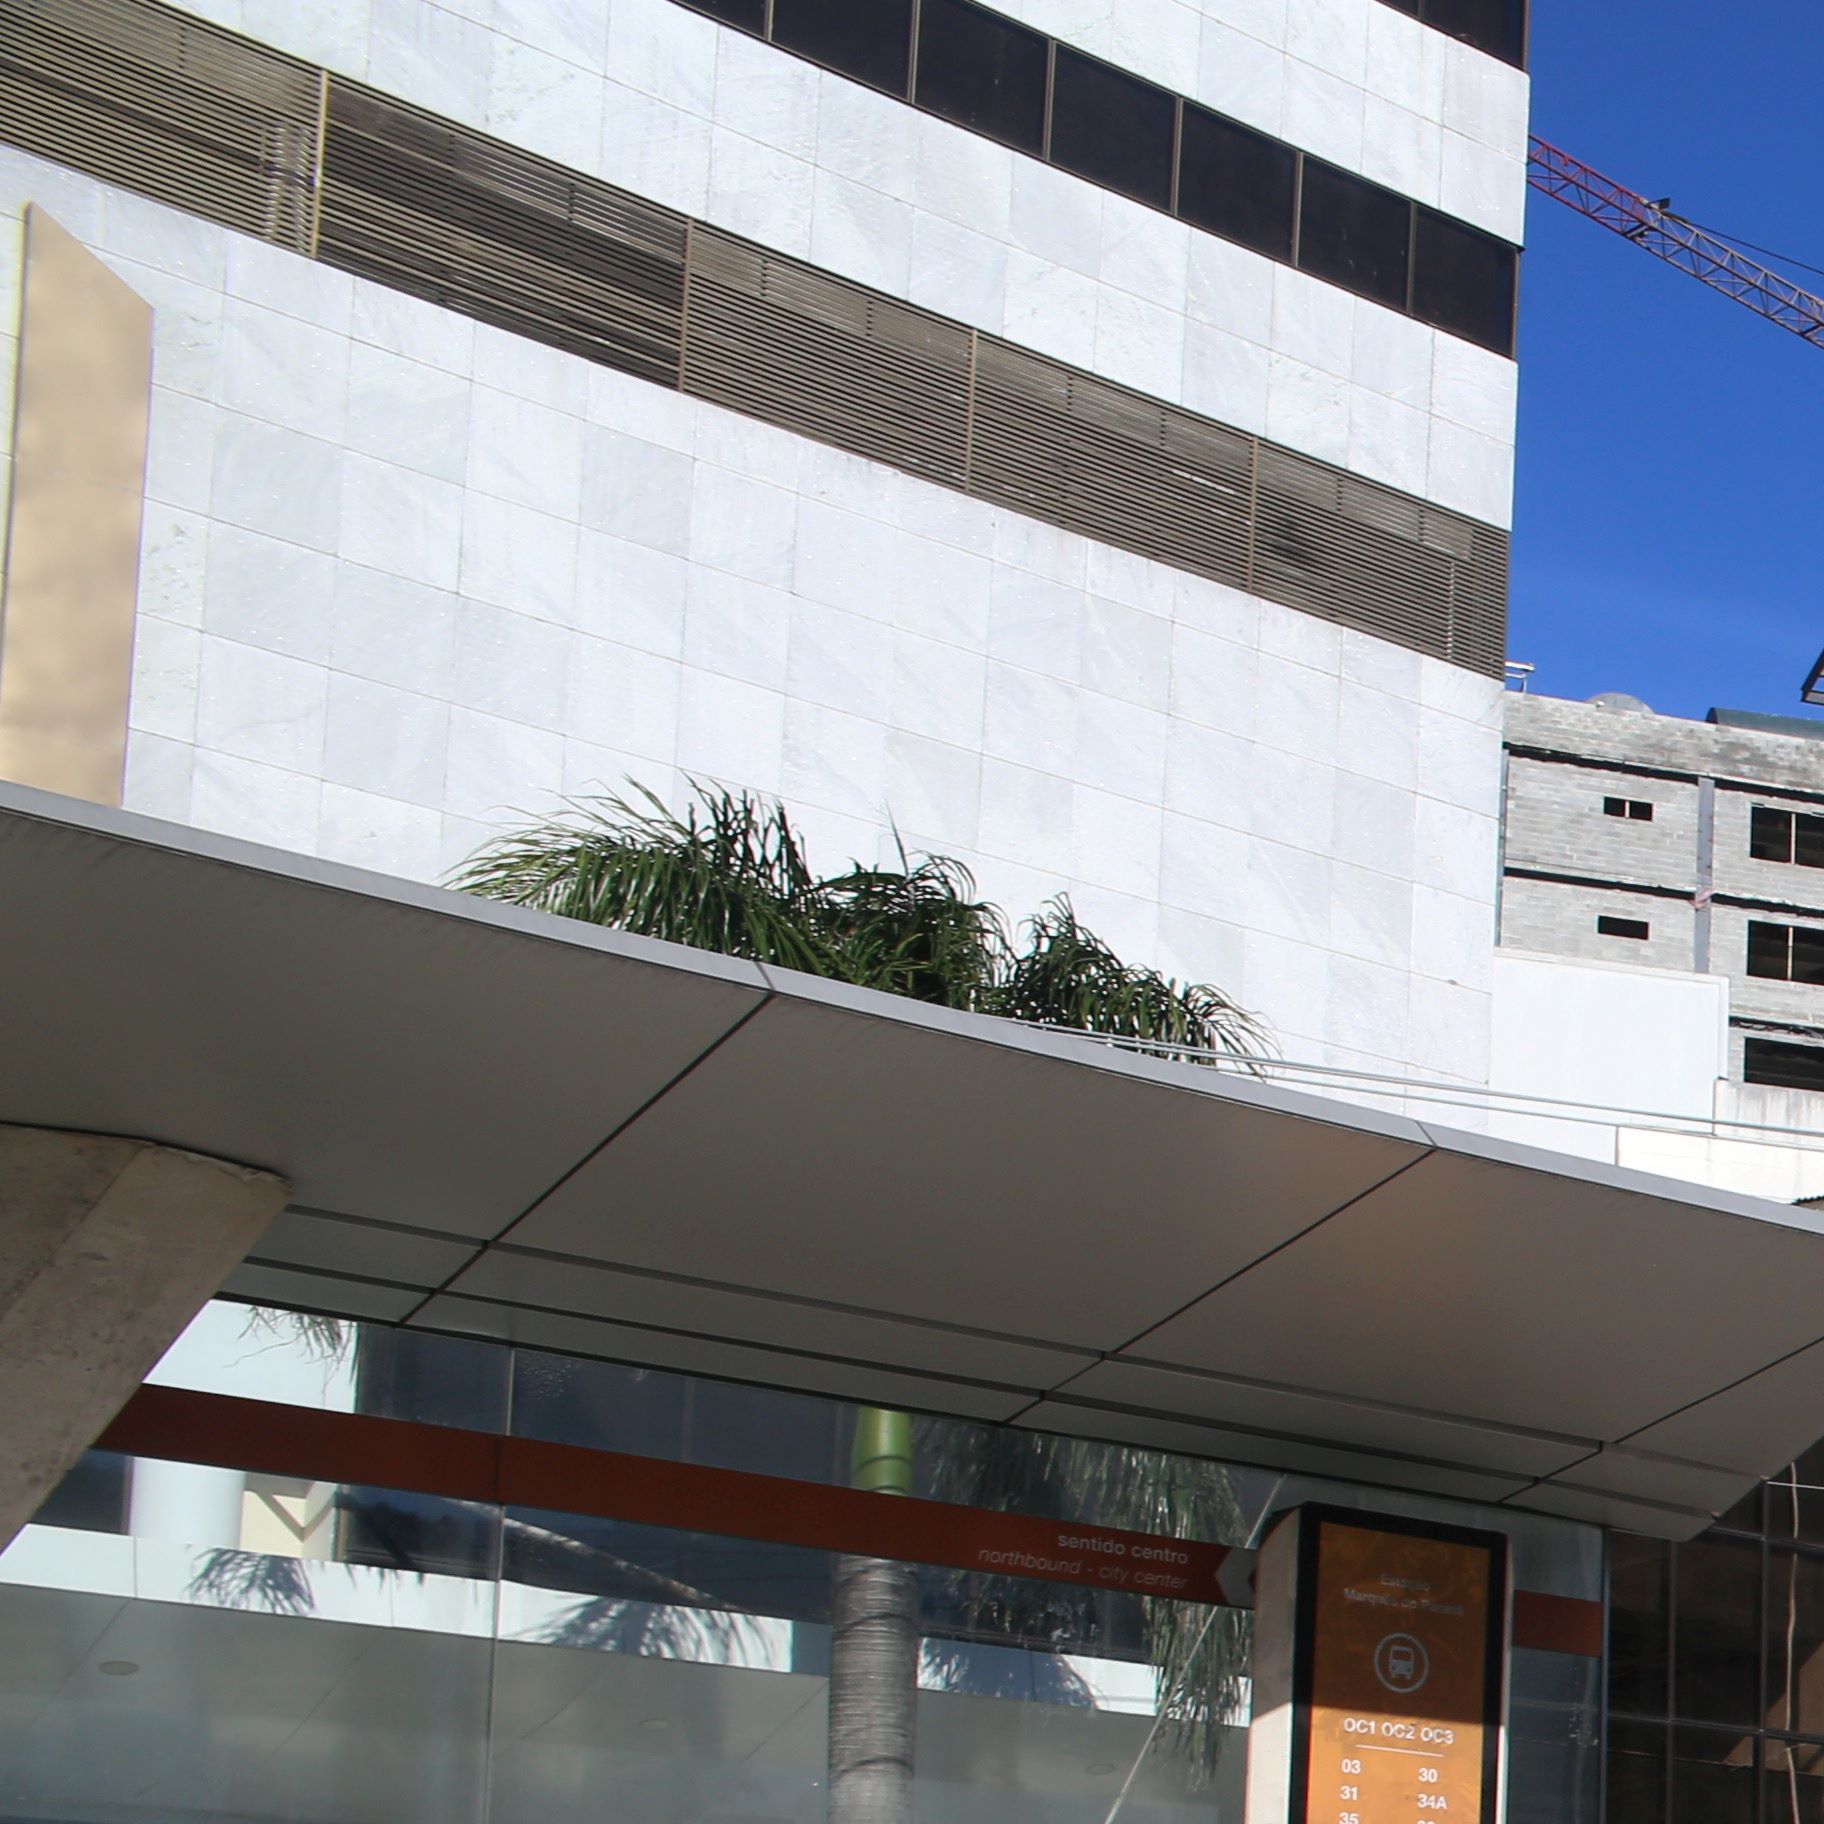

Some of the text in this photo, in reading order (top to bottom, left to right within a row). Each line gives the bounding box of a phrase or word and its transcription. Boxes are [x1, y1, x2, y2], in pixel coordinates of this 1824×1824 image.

[1057, 1533, 1189, 1565] sentido centro
[978, 1549, 1082, 1575] northbound
[1099, 1564, 1129, 1584] city
[1133, 1570, 1190, 1590] center
[1343, 1717, 1454, 1745] OC1 OC2 OC3
[1341, 1758, 1361, 1774] 03
[1418, 1767, 1438, 1783] 30
[1340, 1785, 1358, 1801] 31
[1417, 1793, 1448, 1810] 34A
